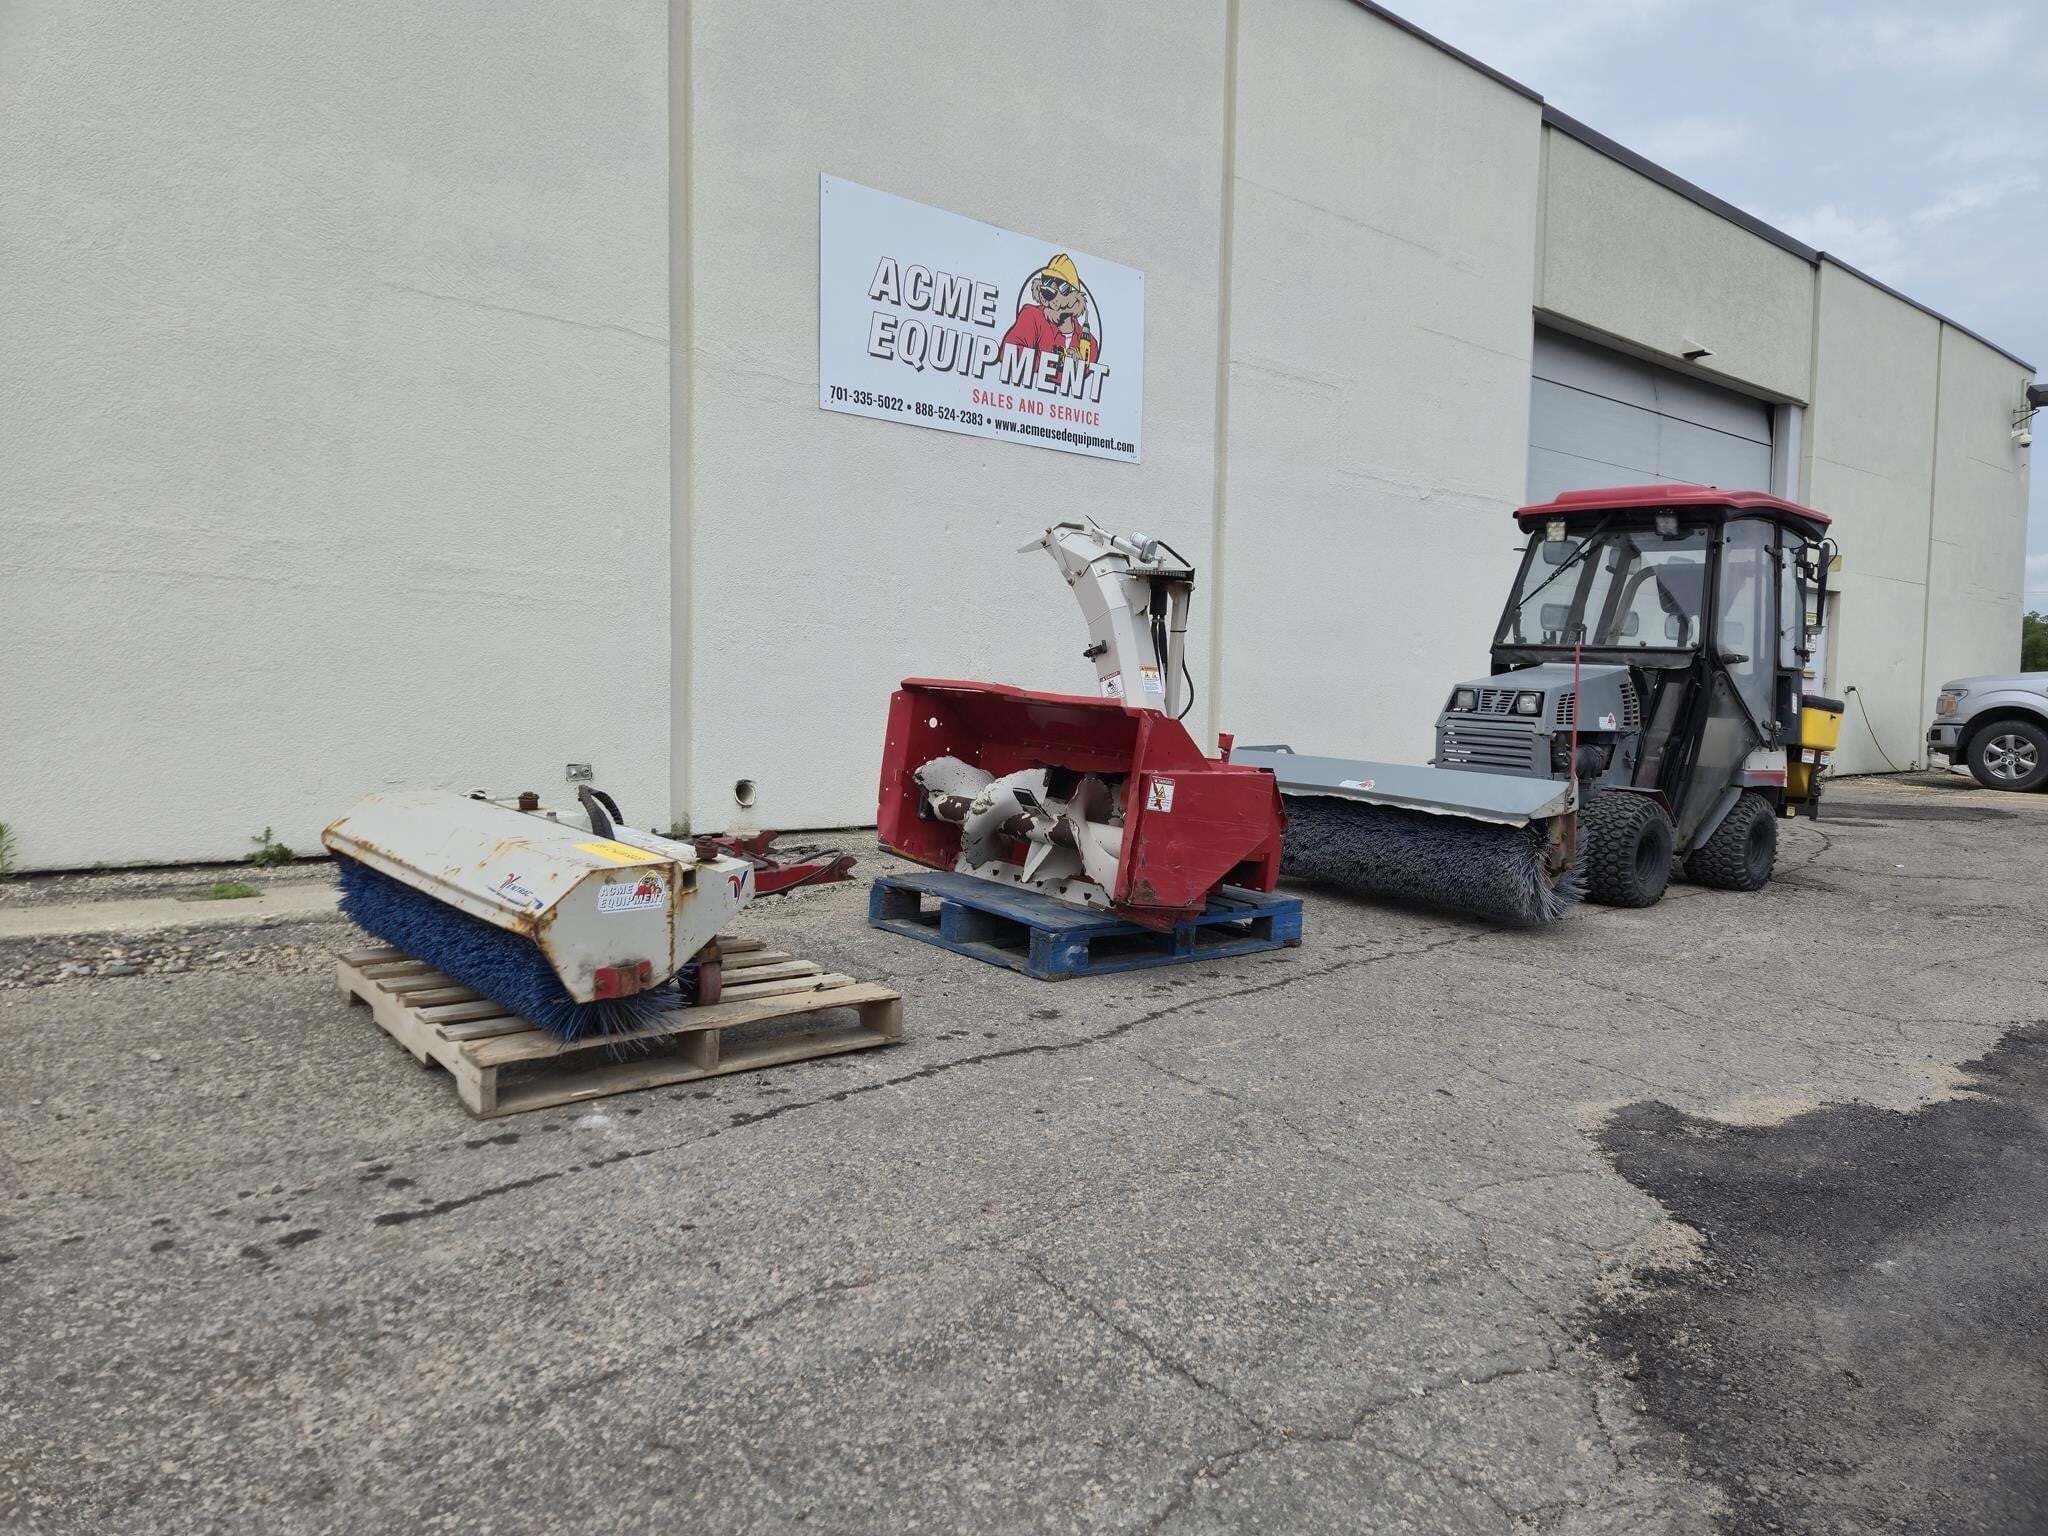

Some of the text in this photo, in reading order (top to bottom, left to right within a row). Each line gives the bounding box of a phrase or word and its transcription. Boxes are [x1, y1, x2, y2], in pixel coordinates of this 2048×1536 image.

[868, 256, 999, 328] ACME
[867, 311, 1110, 403] EQUIPMENT
[829, 385, 1135, 453] 701-335-5022 888-524-2383 www.acmeusedequipment.com
[972, 388, 1100, 426] SALES AND SERVICE
[599, 893, 666, 909] EQUIPMENT
[600, 885, 634, 897] ACME
